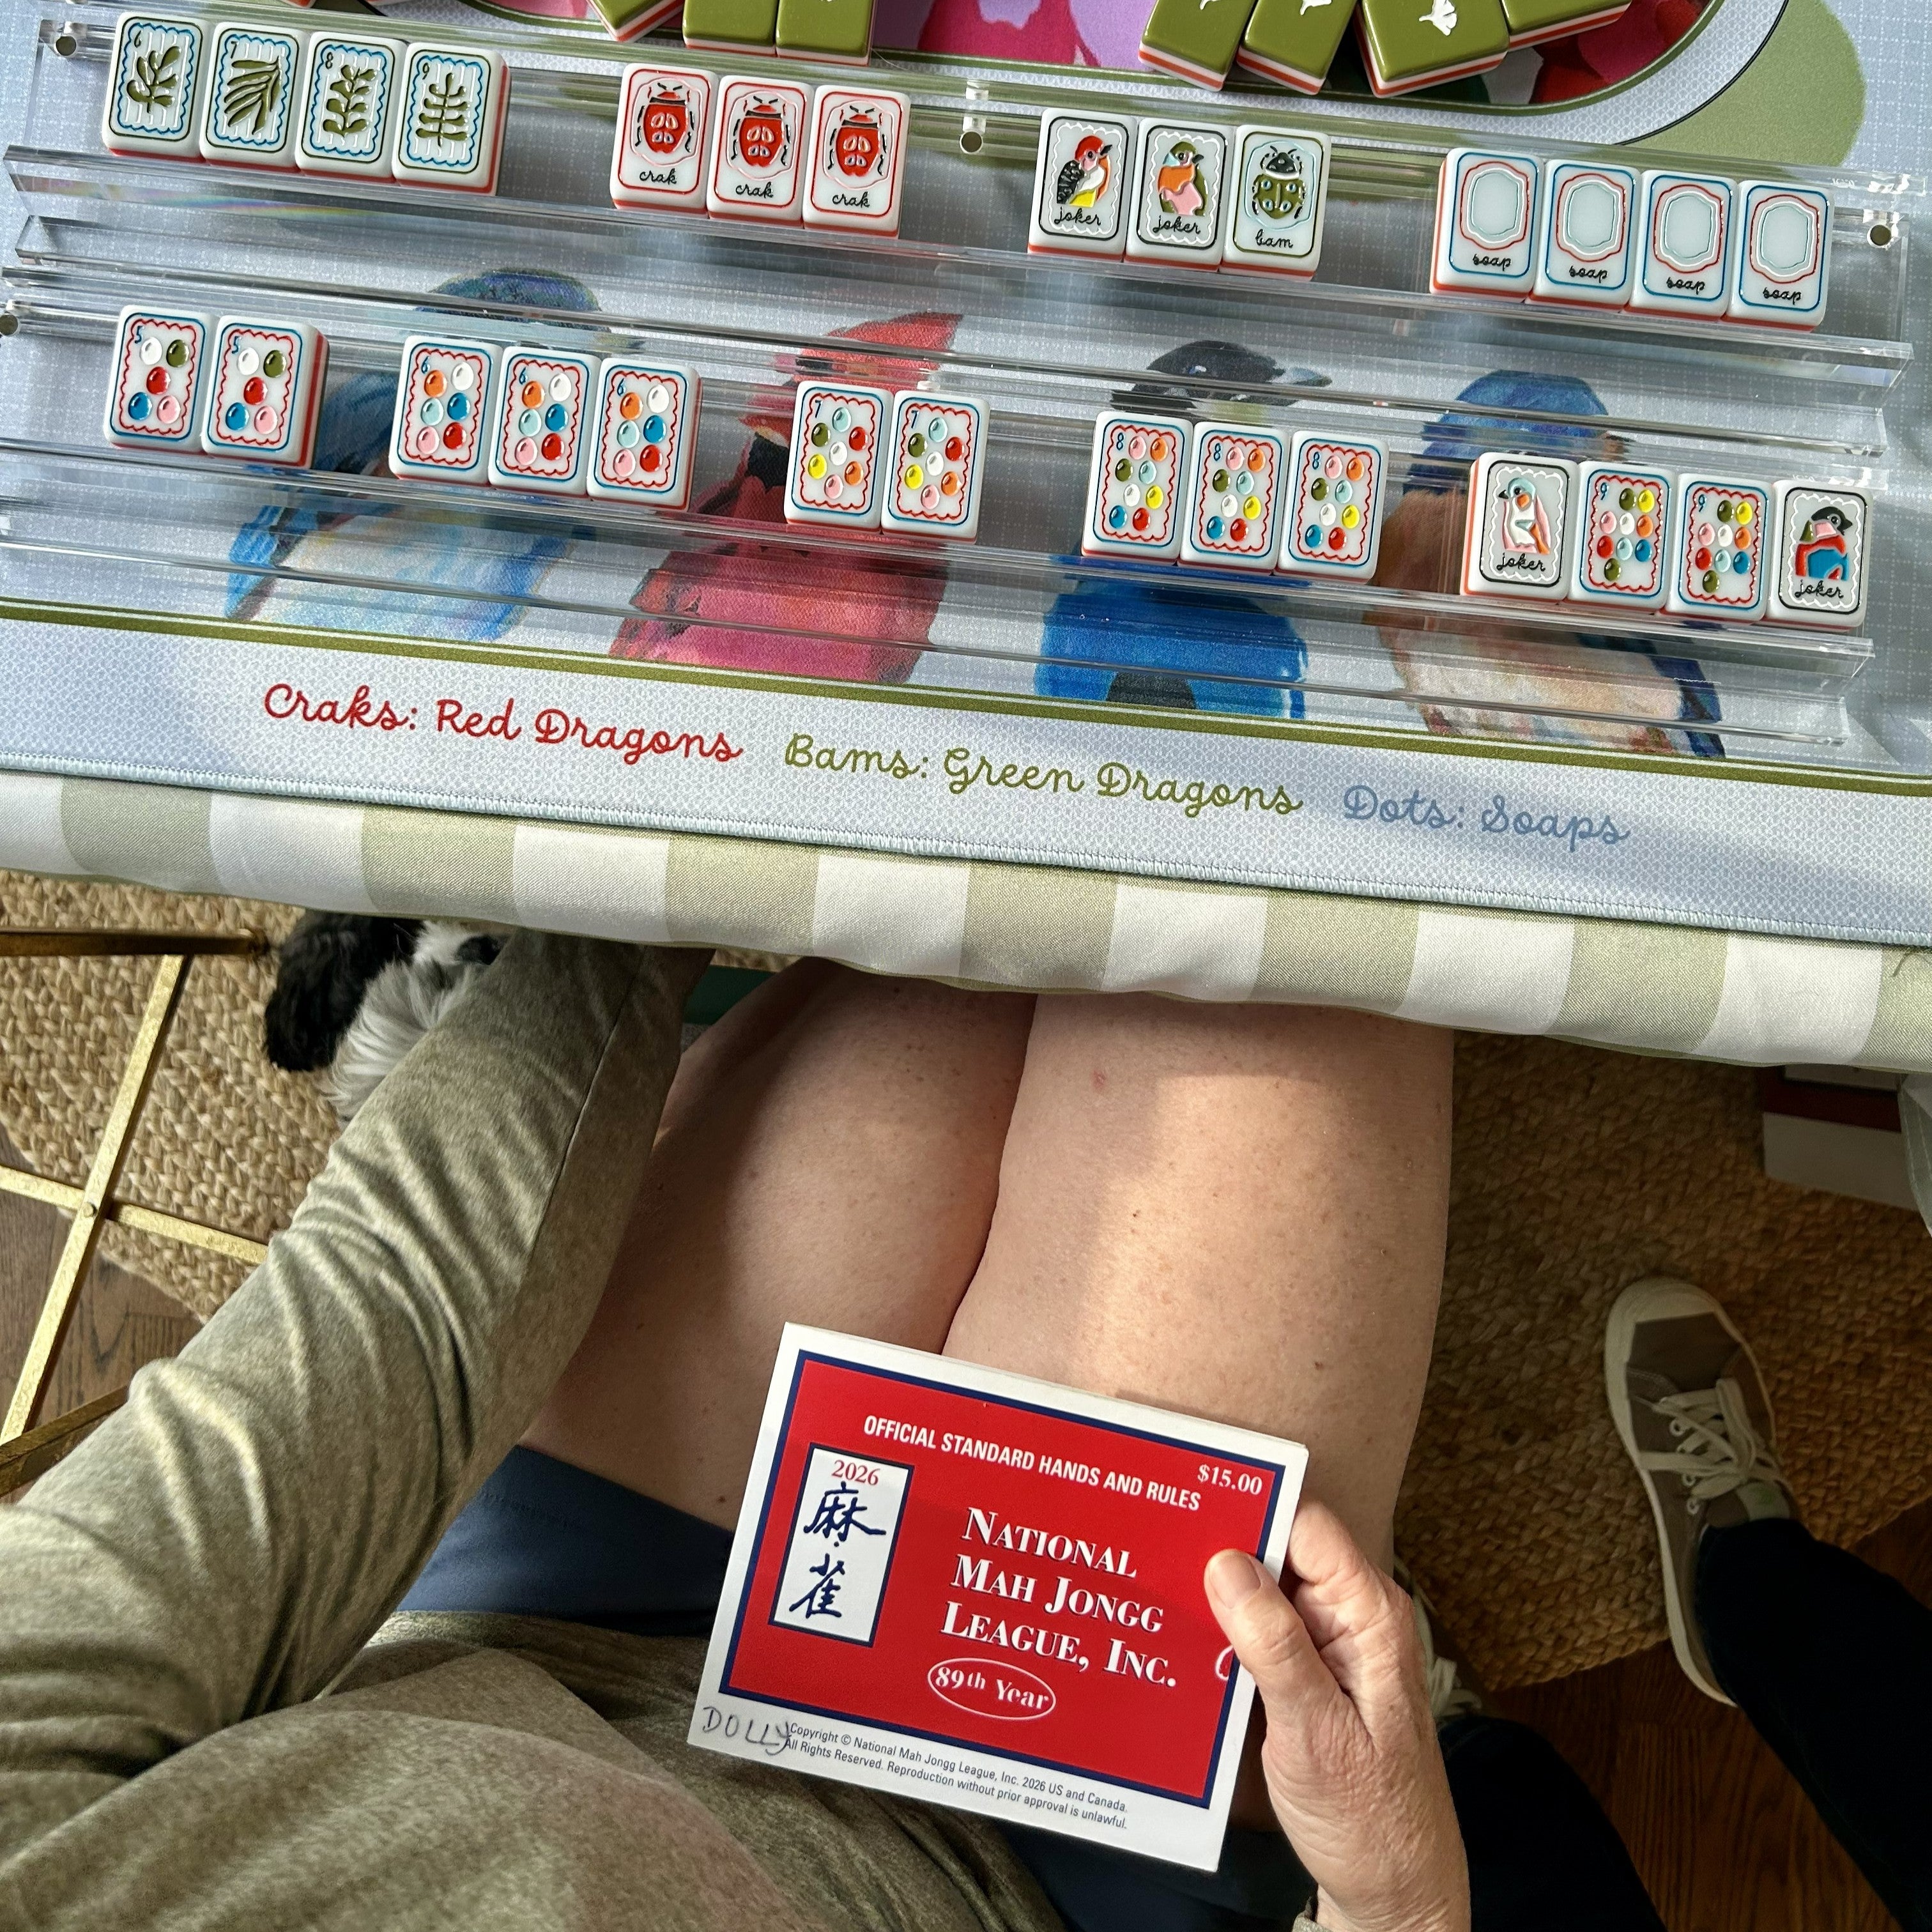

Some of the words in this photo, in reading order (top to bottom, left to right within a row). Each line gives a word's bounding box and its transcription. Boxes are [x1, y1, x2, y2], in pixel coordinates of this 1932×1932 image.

[134, 30, 142, 48] 6
[230, 40, 239, 59] 7
[325, 51, 334, 70] 8
[422, 62, 430, 80] 9
[640, 167, 677, 185] crak
[735, 181, 774, 198] crak
[832, 191, 870, 208] crak
[1054, 206, 1101, 226] joker
[1152, 215, 1201, 235] joker
[1255, 229, 1294, 249] bam
[1472, 253, 1512, 272] soap
[1568, 265, 1608, 284] soap
[1666, 276, 1706, 295] soap
[1762, 287, 1802, 306] soap
[134, 325, 142, 344] 5
[231, 335, 240, 354] 5
[420, 355, 429, 374] 6
[518, 366, 526, 385] 6
[616, 378, 625, 397] 6
[815, 399, 822, 418] 7
[910, 410, 919, 429] 7
[1116, 432, 1124, 451] 8
[1213, 442, 1222, 461] 8
[1312, 451, 1320, 470] 8
[1600, 482, 1608, 500] 9
[1698, 493, 1706, 512] 9
[1496, 552, 1546, 572] joker
[1794, 579, 1844, 599] joker
[264, 682, 418, 731] Craks:
[436, 698, 522, 741] Red
[534, 708, 744, 765] Dragons
[785, 732, 930, 779] Bams:
[943, 746, 1085, 795] Green
[1096, 761, 1304, 818] Dragons
[1343, 785, 1466, 829] Dots:
[1481, 793, 1632, 852] Soaps
[831, 1459, 881, 1486] 2026
[863, 1414, 937, 1450] OFFICIAL
[940, 1431, 1035, 1471] STANDARD
[1038, 1453, 1101, 1486] HANDS
[1103, 1469, 1144, 1496] AND
[1146, 1481, 1202, 1512] RULES
[1196, 1463, 1263, 1496] $15.00
[960, 1506, 1138, 1579] NATIONAL
[950, 1552, 1038, 1604] MAH
[1043, 1575, 1164, 1634] JONGG
[940, 1600, 1089, 1673] LEAGUE,
[1103, 1637, 1177, 1688] INC.
[934, 1666, 986, 1690] 89th
[995, 1678, 1051, 1710] Year
[703, 1706, 792, 1756] DOLLY
[790, 1722, 839, 1744] Copyright
[854, 1736, 897, 1757] National
[899, 1747, 922, 1763] Mah
[924, 1753, 956, 1772] Jongg
[959, 1761, 998, 1782] League,
[1001, 1770, 1020, 1786] Inc.
[1022, 1777, 1046, 1792] 2026
[1049, 1782, 1064, 1796] US
[1066, 1790, 1085, 1802] and
[1087, 1792, 1128, 1813] Canada.
[784, 1736, 799, 1751] All
[801, 1740, 832, 1759] Rights
[834, 1751, 884, 1770] Reserved.
[887, 1761, 954, 1787] Reproduction
[957, 1777, 995, 1797] without
[997, 1788, 1022, 1804] prior
[1023, 1794, 1069, 1815] approval
[1070, 1804, 1080, 1816] is
[1081, 1809, 1128, 1830] unlawful.
